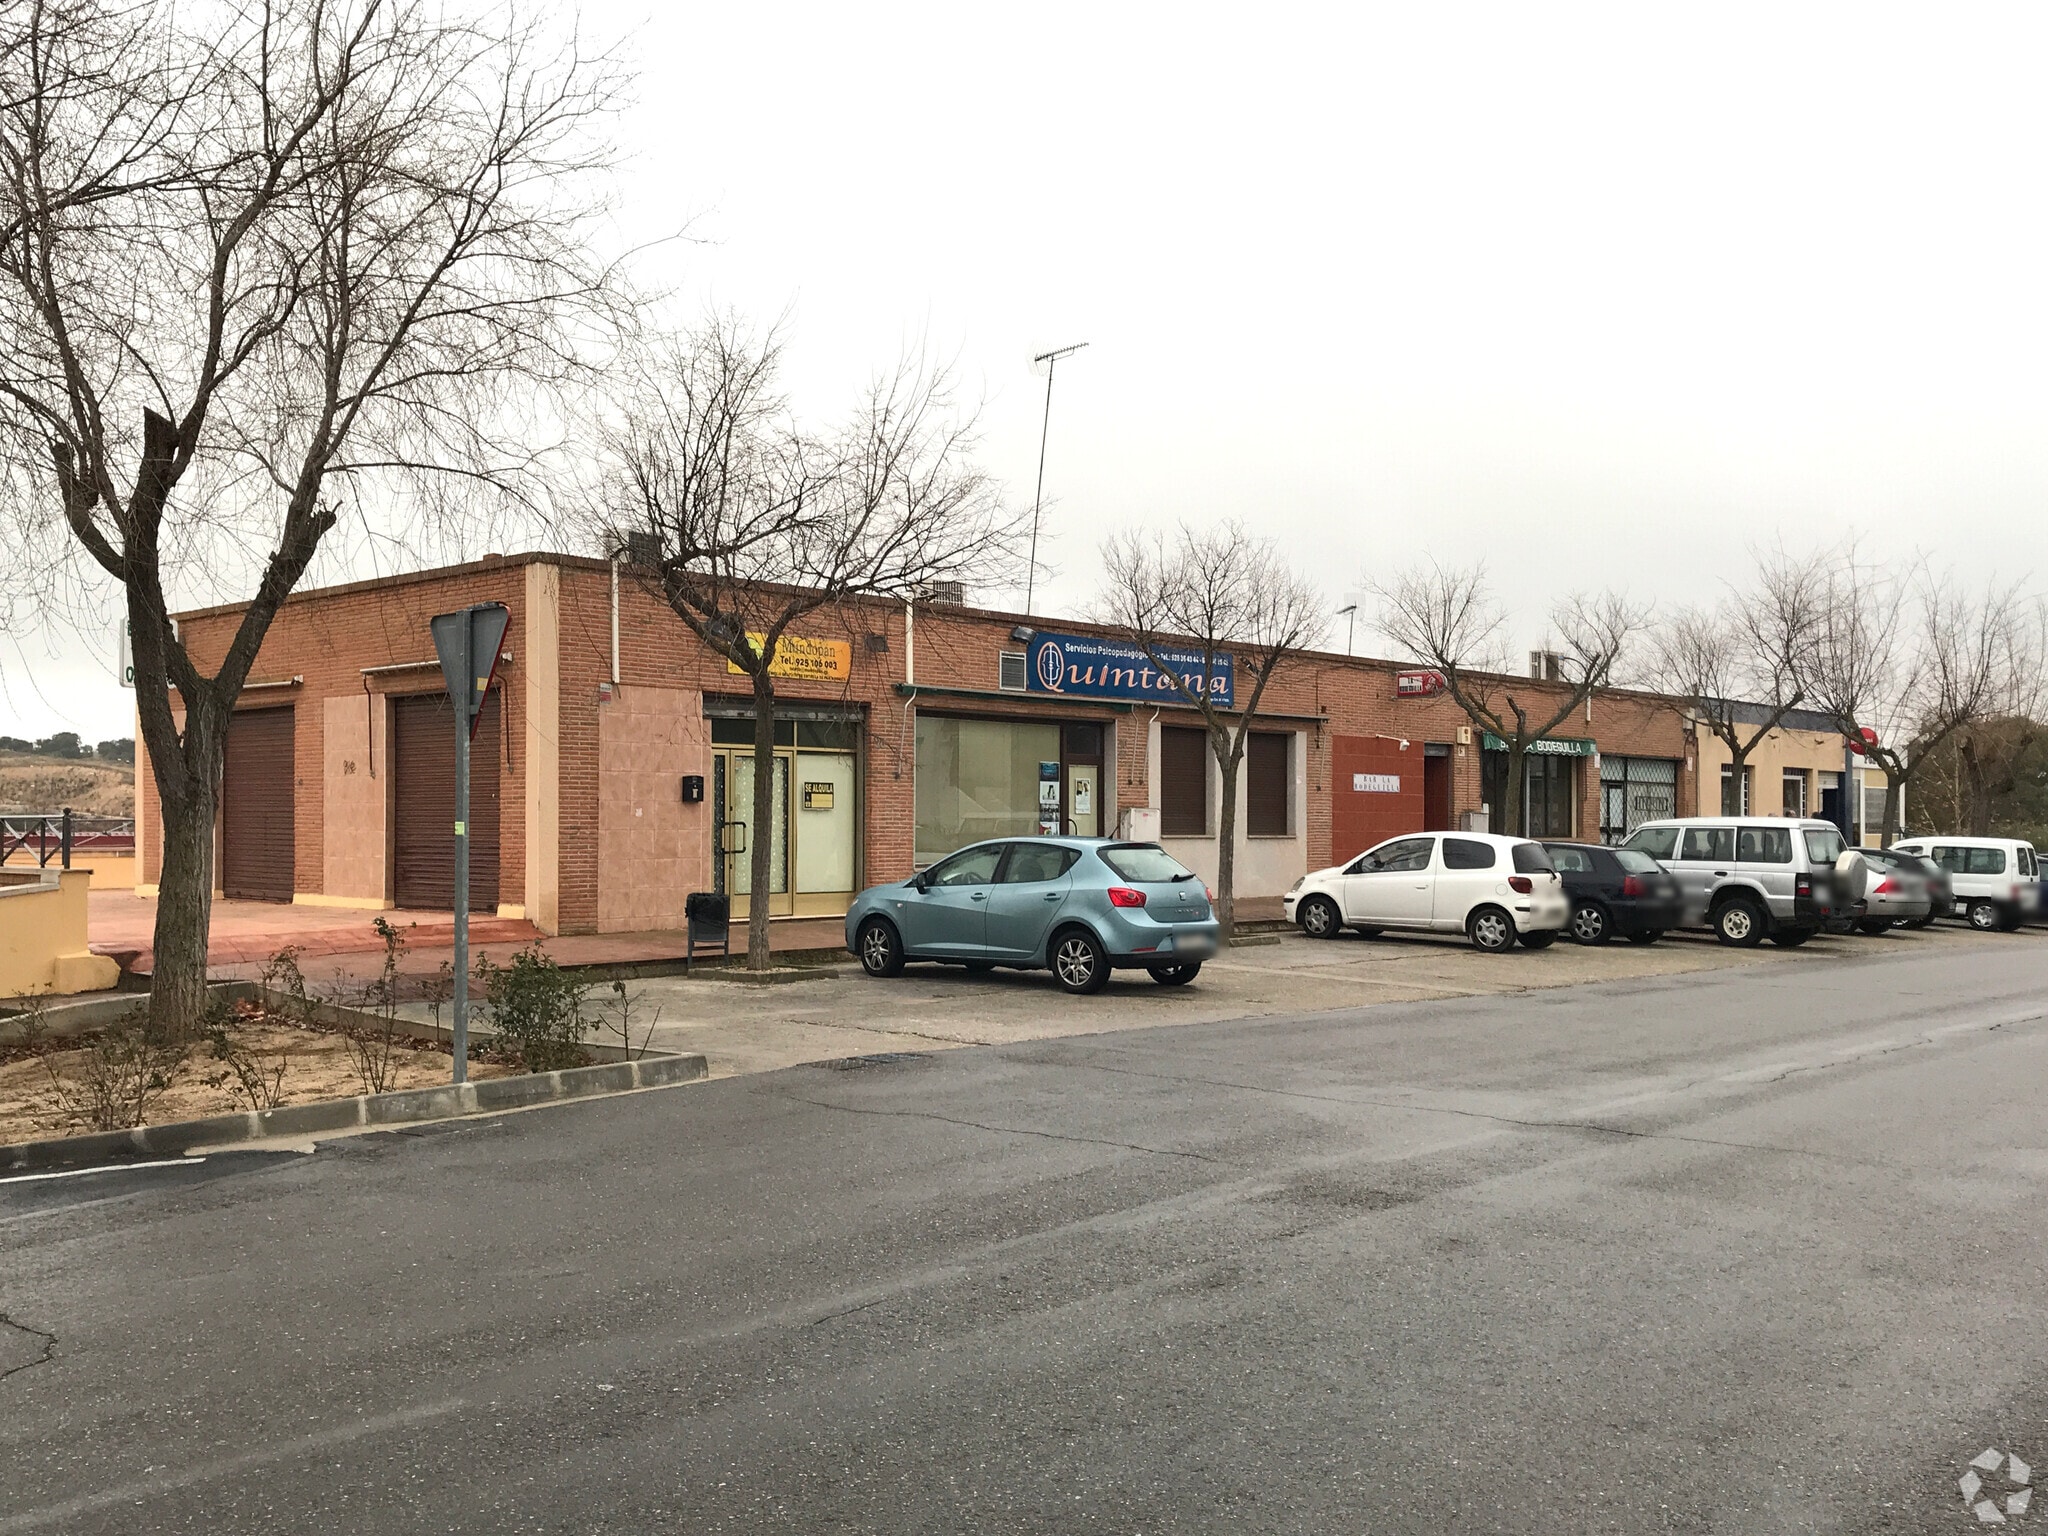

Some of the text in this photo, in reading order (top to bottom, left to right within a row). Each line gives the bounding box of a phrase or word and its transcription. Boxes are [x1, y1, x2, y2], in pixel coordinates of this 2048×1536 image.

[1065, 642, 1097, 655] Servicios
[1097, 646, 1157, 660] Psicopedagógic
[780, 655, 838, 670] Tel. 925 106 003
[1037, 641, 1229, 694] Quintana
[1536, 740, 1582, 754] BODEGUILLA
[805, 783, 833, 793] SE ALQUILA
